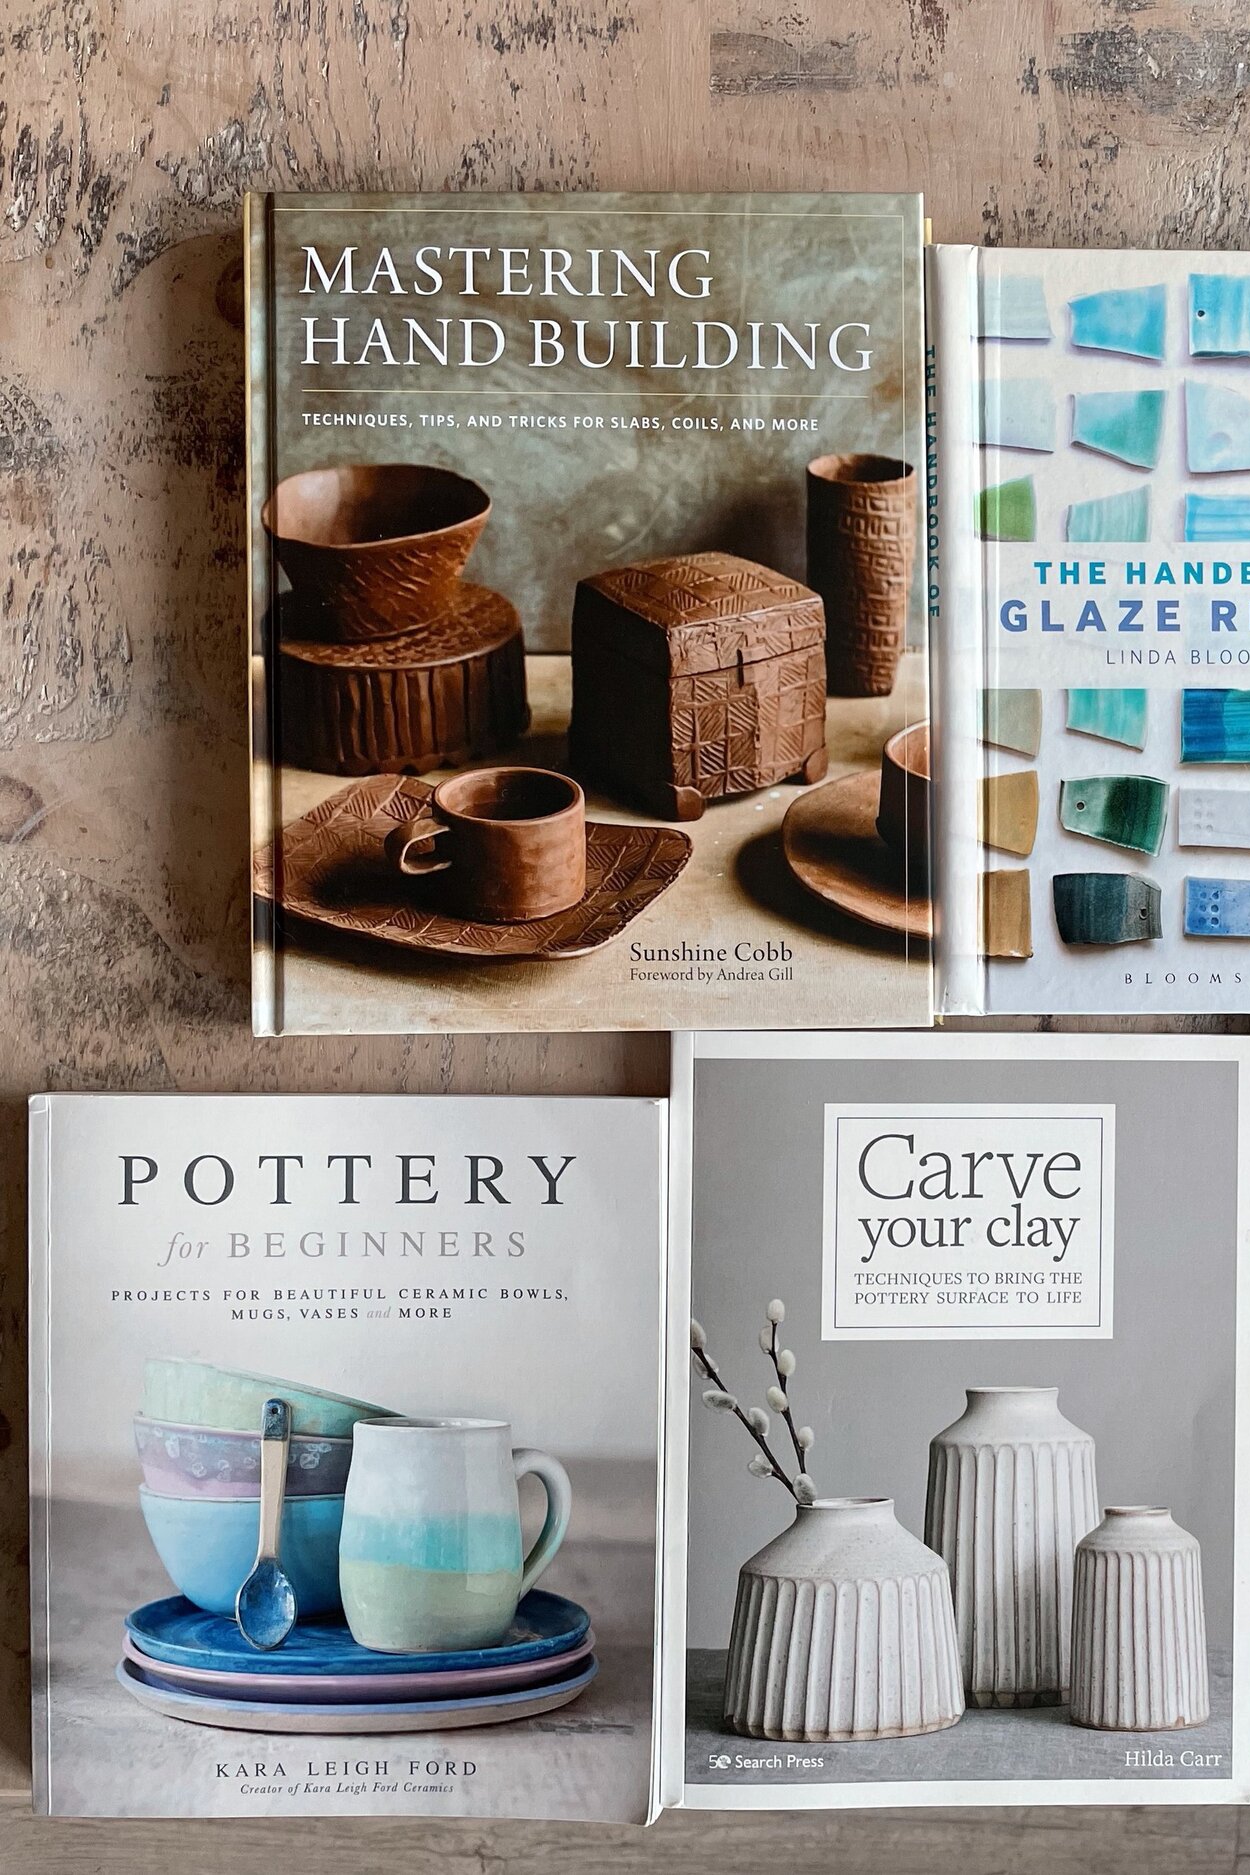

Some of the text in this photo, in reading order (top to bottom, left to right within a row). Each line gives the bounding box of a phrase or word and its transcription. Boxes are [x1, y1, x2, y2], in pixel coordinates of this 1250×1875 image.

[299, 245, 714, 299] MASTERING
[301, 317, 875, 372] HAND BUILDING
[302, 412, 819, 431] TECHNIQUES, TIPS, AND TRICKS FOR SLABS, COILS, AND MORE
[926, 345, 940, 618] THE HANDBOOK OF
[1034, 562, 1106, 584] THE
[1000, 600, 1181, 633] GLAZE
[1106, 650, 1175, 665] LINDA
[630, 941, 793, 961] Sunshine Cobb
[630, 967, 793, 984] Foreword by Andrea Gill
[858, 1133, 1082, 1200] Carve
[117, 1155, 577, 1205] POTTERY
[857, 1203, 1080, 1263] your clay
[157, 1231, 527, 1267] for BEGINNERS
[854, 1272, 1083, 1287] TECHNIQUES TO BRING THE
[111, 1287, 570, 1302] PROJECTS FOR BEAUTIFUL CERAMIC BOWLS,
[854, 1291, 1082, 1305] POTTERY SURFACE TO LIFE
[231, 1305, 453, 1321] MUGS, VASES and MORE
[215, 1760, 478, 1778] KARA LEIGH FORD
[735, 1754, 782, 1769] Search
[786, 1754, 824, 1768] Press
[1125, 1751, 1223, 1768] Hilda Carr
[240, 1782, 454, 1796] Creator of Kara Leigh Ford Ceramics
